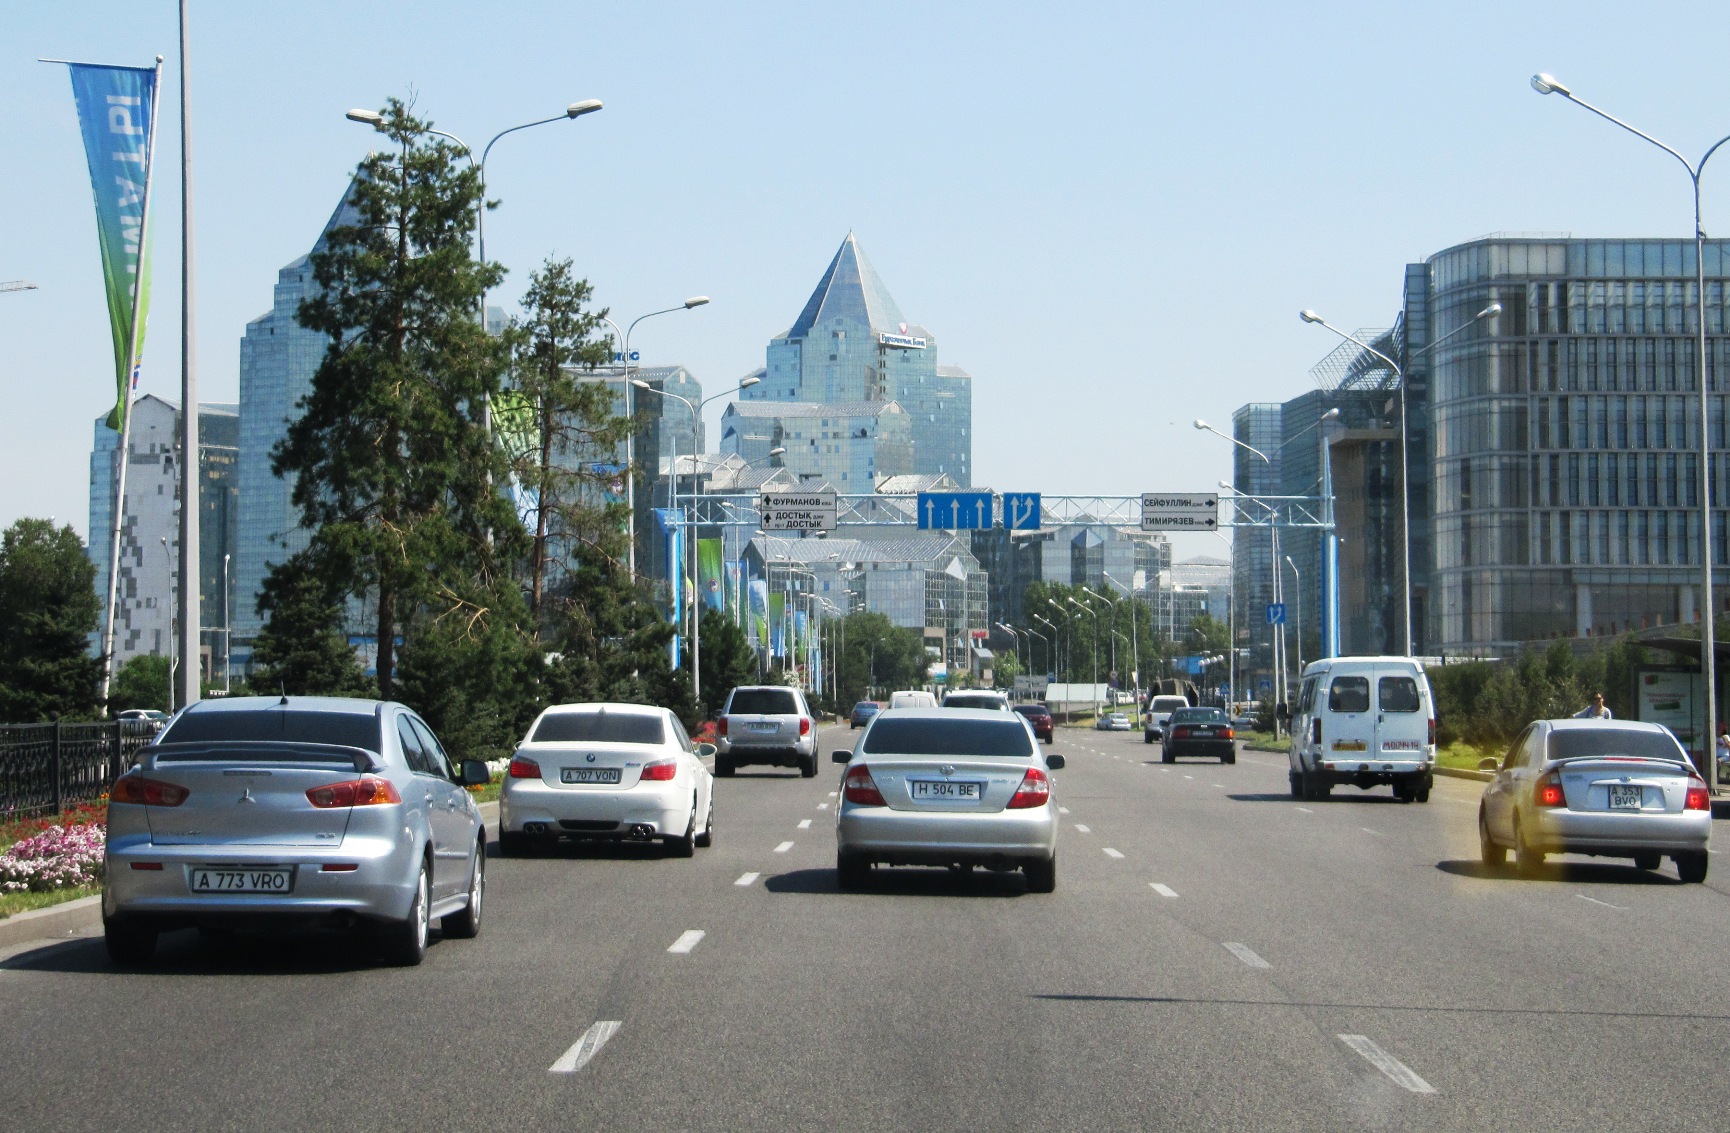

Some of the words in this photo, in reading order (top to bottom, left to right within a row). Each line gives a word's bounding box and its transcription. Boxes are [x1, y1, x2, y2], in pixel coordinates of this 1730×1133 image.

[772, 498, 821, 506] ФУРМАНОВ
[1143, 498, 1192, 507] СЕЙФУЛЛИН
[1144, 517, 1194, 525] ТИМИРЯЗЕВ
[565, 771, 572, 780] A
[575, 771, 593, 780] 707
[595, 771, 616, 780] VON
[919, 784, 928, 795] H
[933, 784, 954, 796] 504
[960, 784, 974, 796] BE
[1611, 787, 1618, 796] A
[1622, 786, 1640, 796] 353
[1615, 796, 1637, 806] BVO
[199, 873, 210, 888] A
[216, 873, 245, 888] 773
[251, 873, 285, 889] VRO
